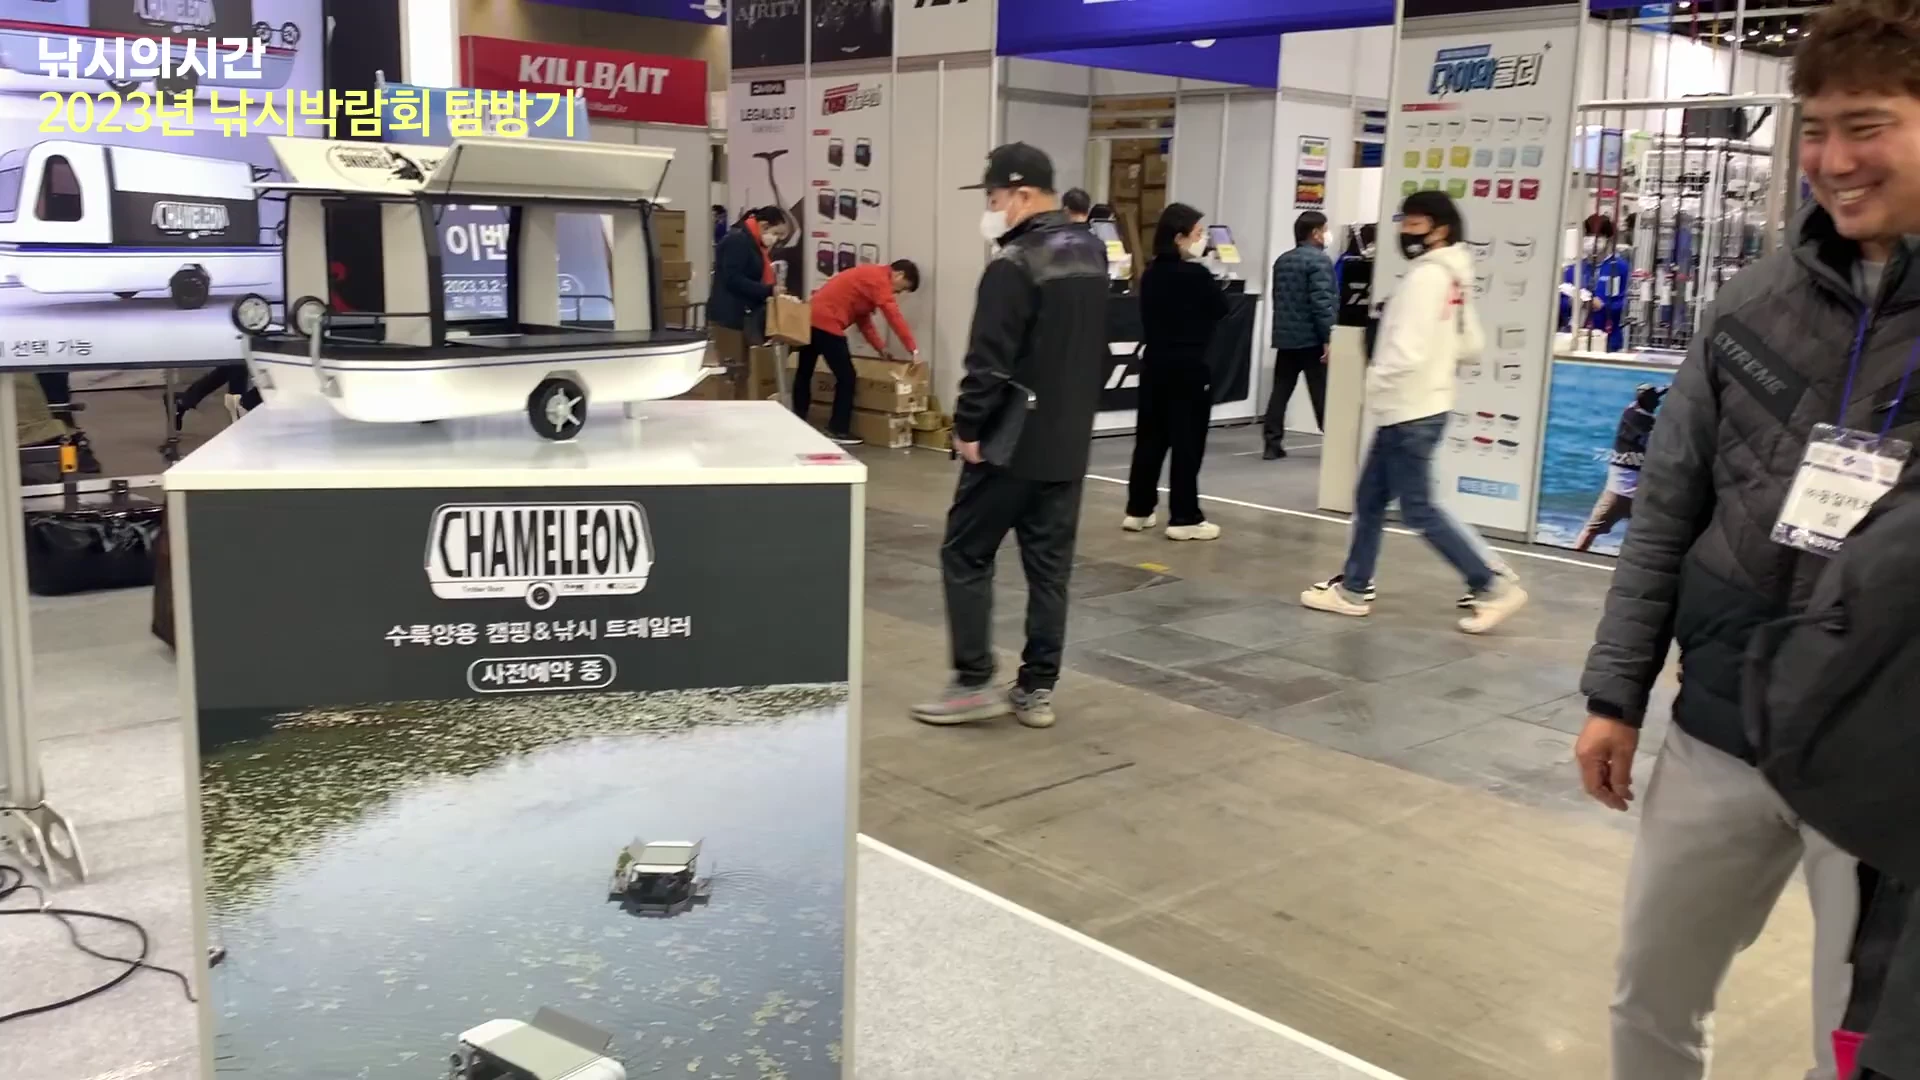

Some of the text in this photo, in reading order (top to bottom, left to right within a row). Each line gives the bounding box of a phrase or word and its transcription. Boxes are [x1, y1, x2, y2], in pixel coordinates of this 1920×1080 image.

[518, 54, 669, 98] KILLBAIT
[740, 106, 796, 122] LEGALIS LT
[446, 223, 510, 261] 이벤
[11, 339, 49, 358] 선택
[56, 338, 93, 356] 가능
[1713, 331, 1788, 395] EXTREME
[439, 508, 639, 578] CHAMELEON
[384, 615, 692, 647] 수륙양용 캠핑&낚시 트레일러
[481, 660, 603, 685] 사전예약 중
